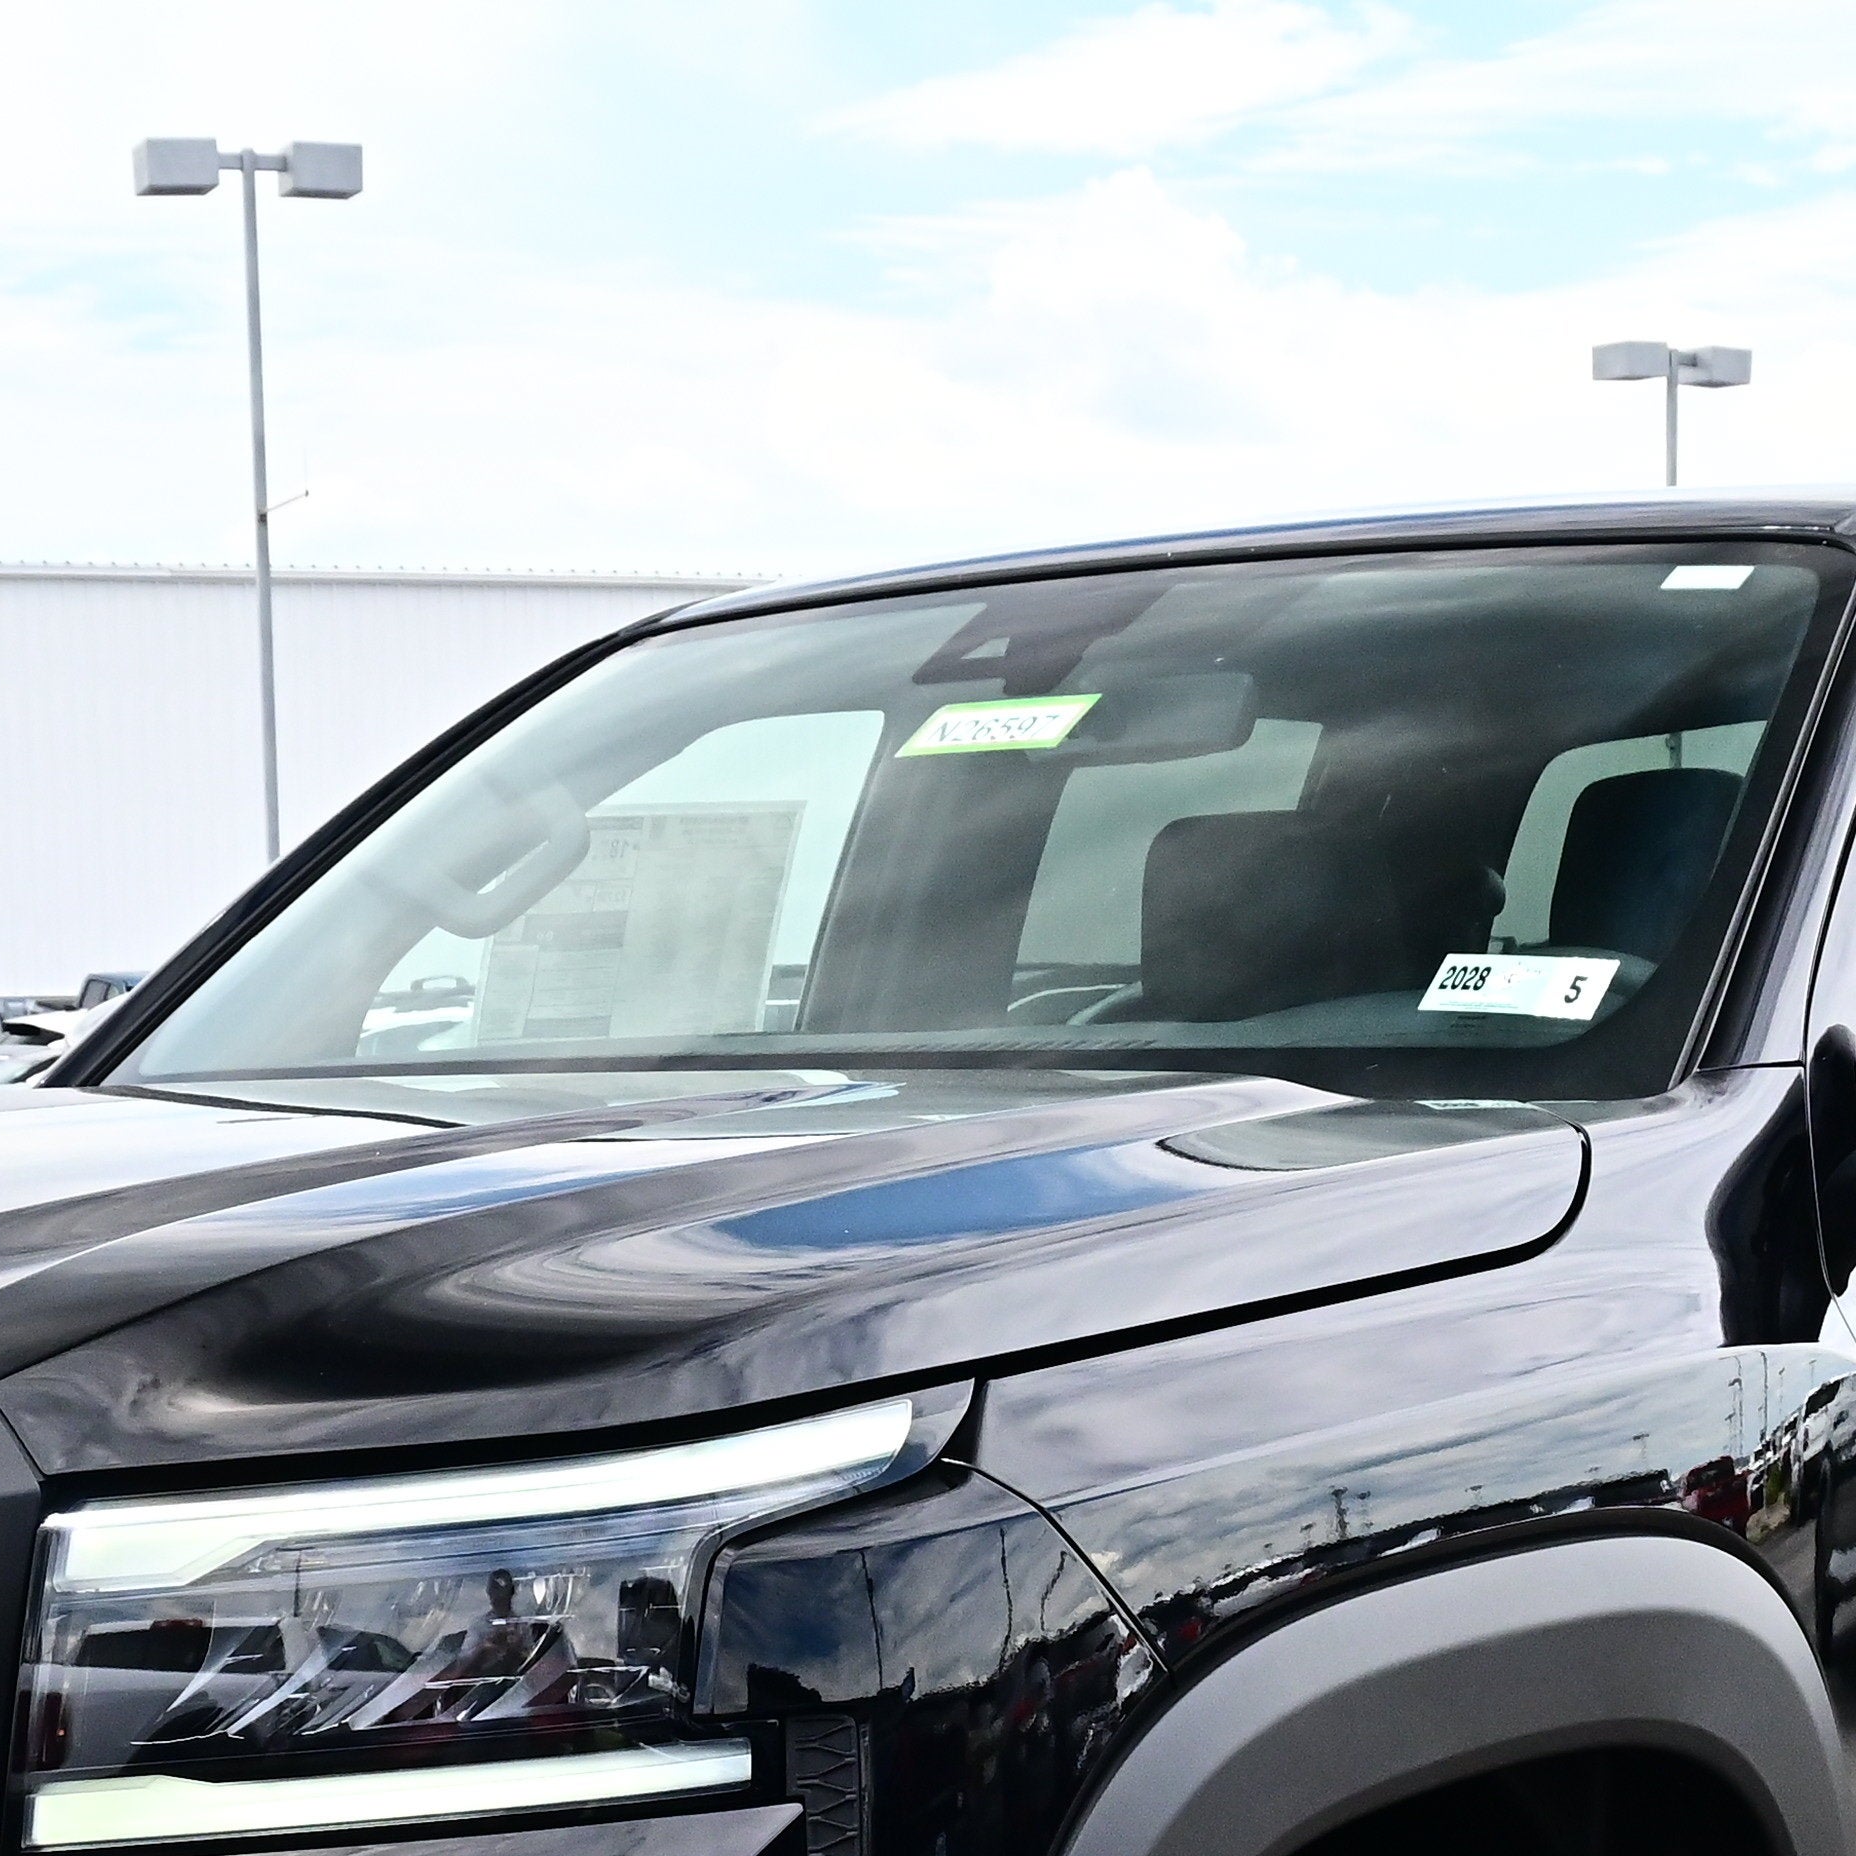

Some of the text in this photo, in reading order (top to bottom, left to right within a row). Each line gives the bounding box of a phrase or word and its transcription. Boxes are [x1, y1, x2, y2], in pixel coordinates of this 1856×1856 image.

[928, 713, 1061, 743] N26597
[1438, 965, 1493, 992] 2028
[1563, 975, 1589, 1004] 5
